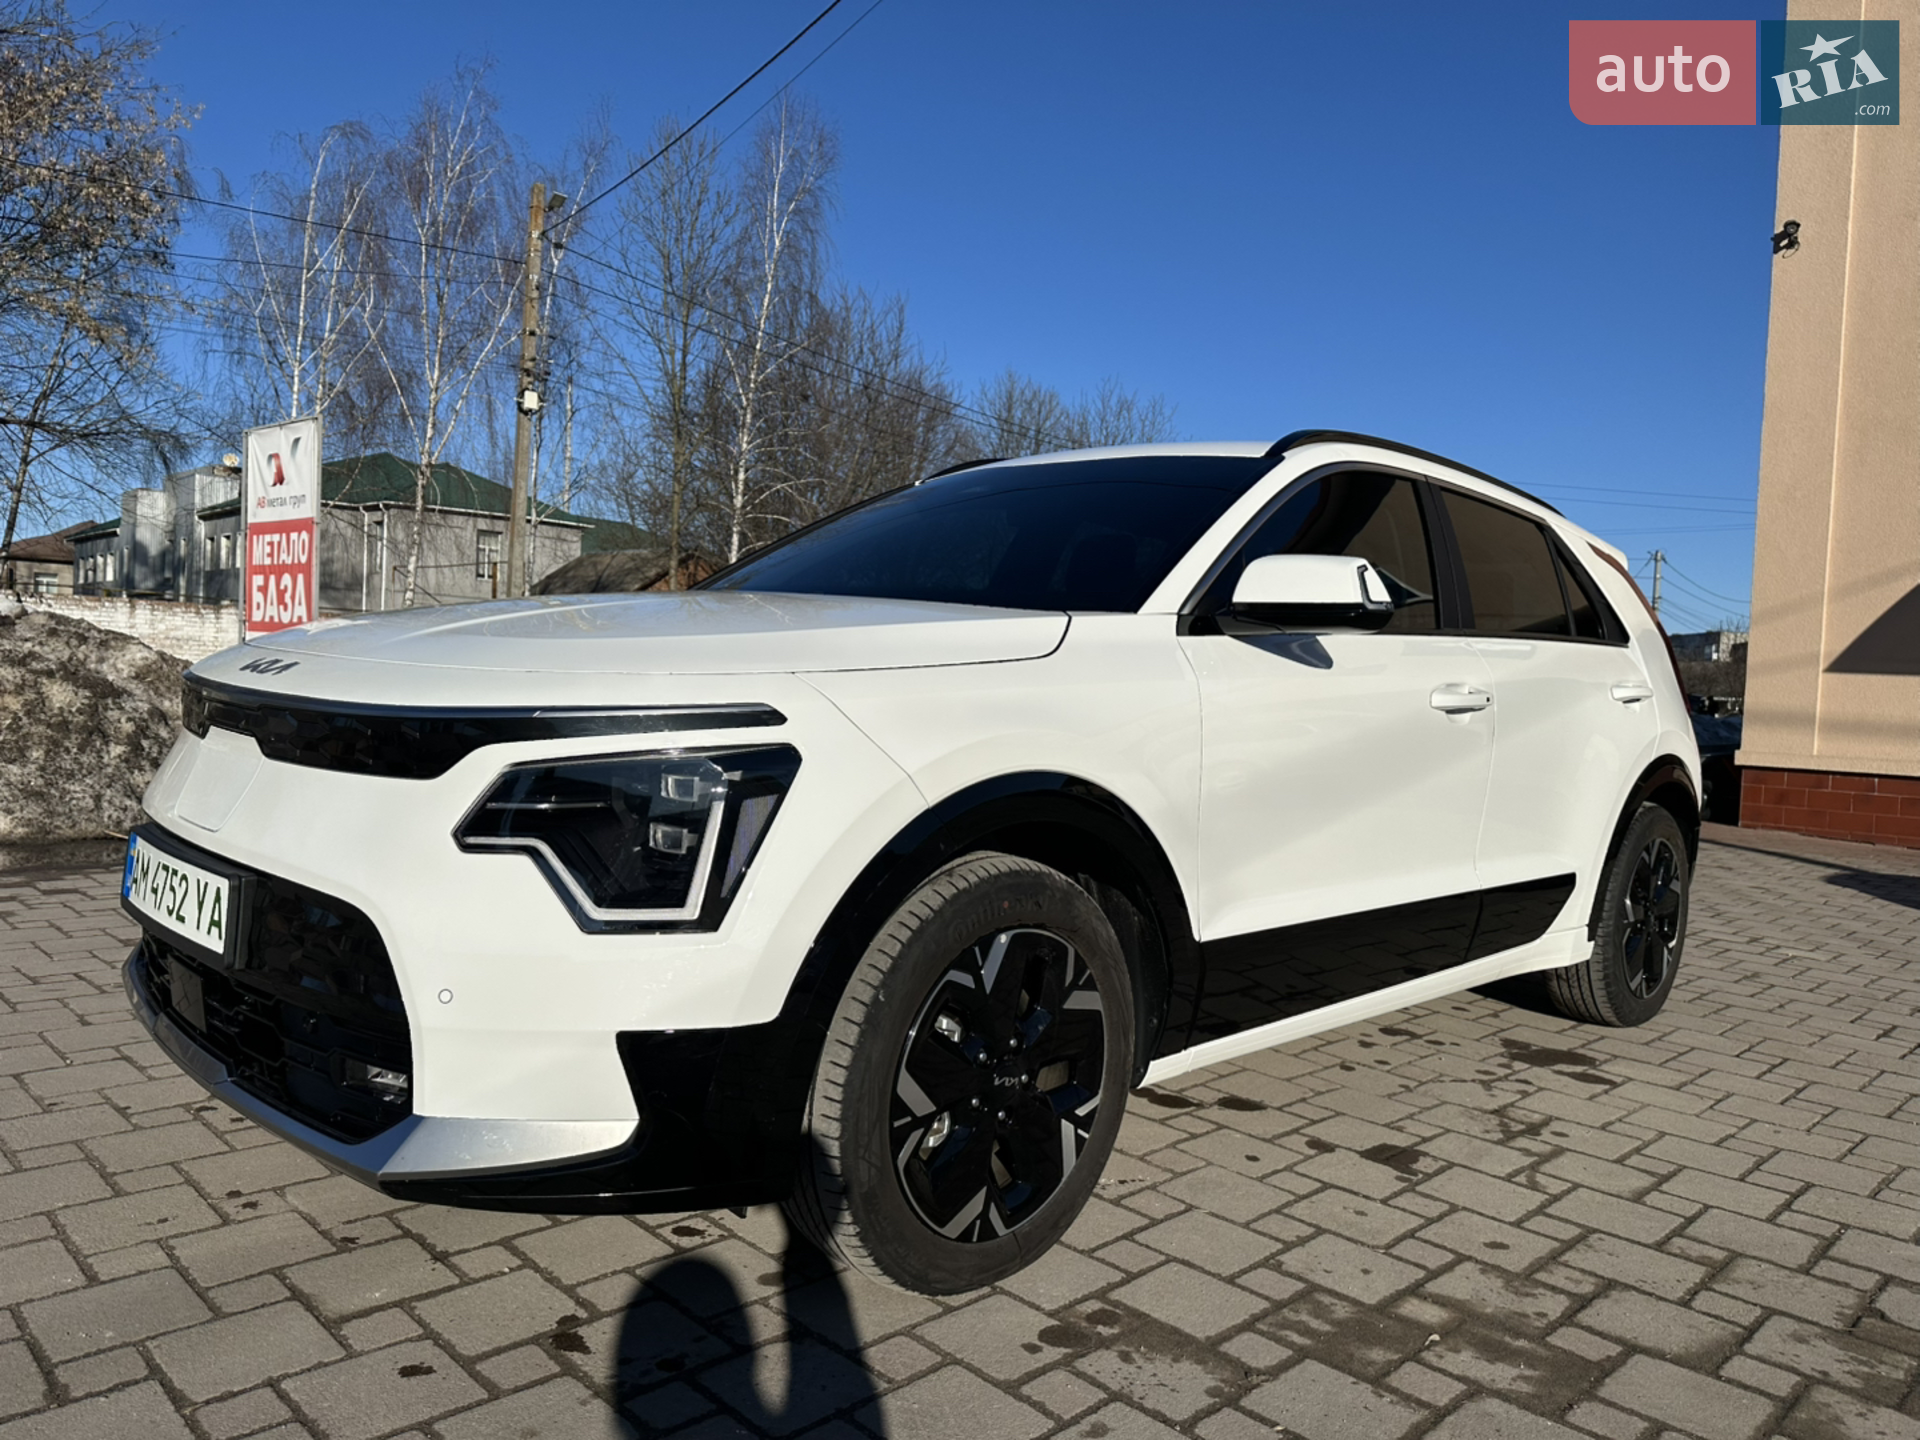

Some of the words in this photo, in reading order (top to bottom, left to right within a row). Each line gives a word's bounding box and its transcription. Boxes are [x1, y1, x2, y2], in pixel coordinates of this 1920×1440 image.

[252, 529, 309, 566] МЕТАЛО
[251, 572, 308, 624] БАЗА
[151, 861, 189, 924] 4752
[196, 877, 223, 941] YA
